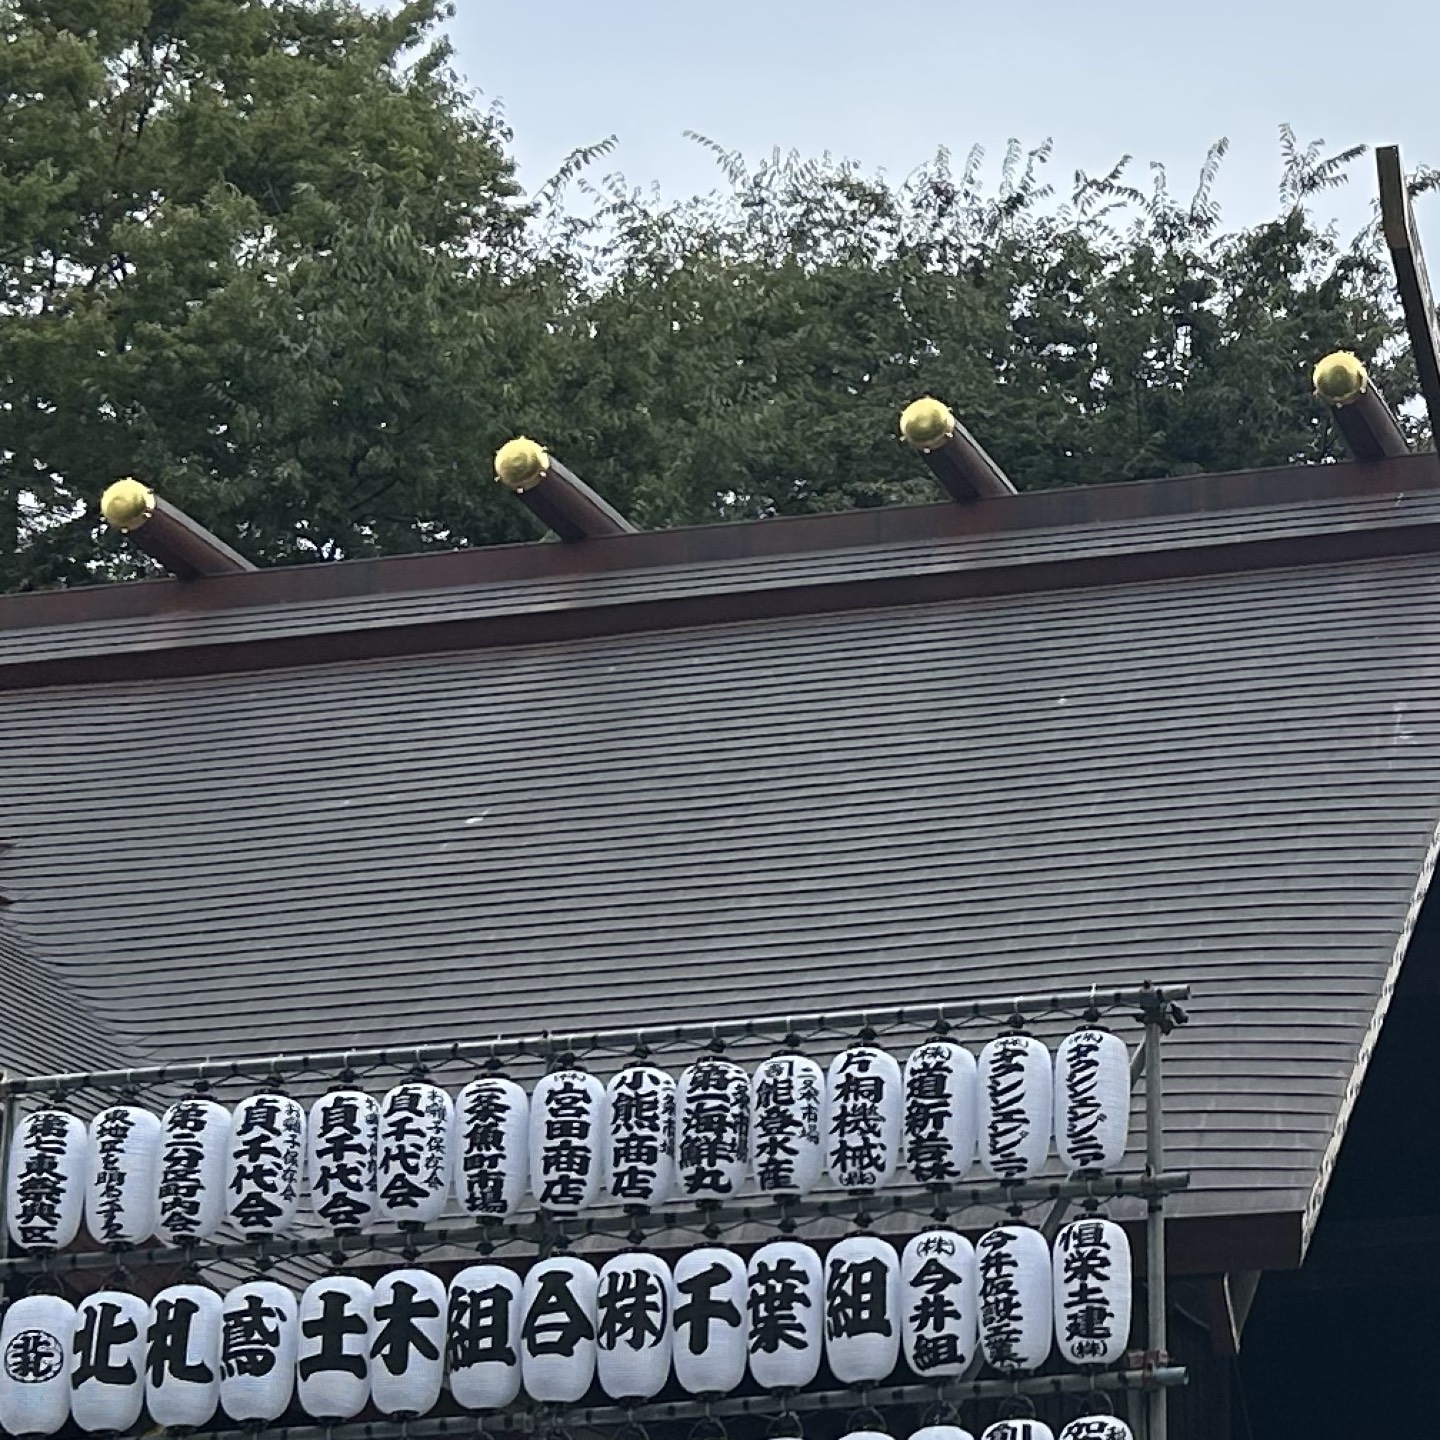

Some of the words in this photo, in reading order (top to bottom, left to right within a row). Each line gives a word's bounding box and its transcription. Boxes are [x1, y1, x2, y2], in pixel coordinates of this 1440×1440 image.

[229, 1098, 283, 1227] 貞千代会
[313, 1096, 371, 1225] 貞千代会
[379, 1085, 430, 1209] 貞千代会
[611, 1071, 660, 1199] 小熊商店
